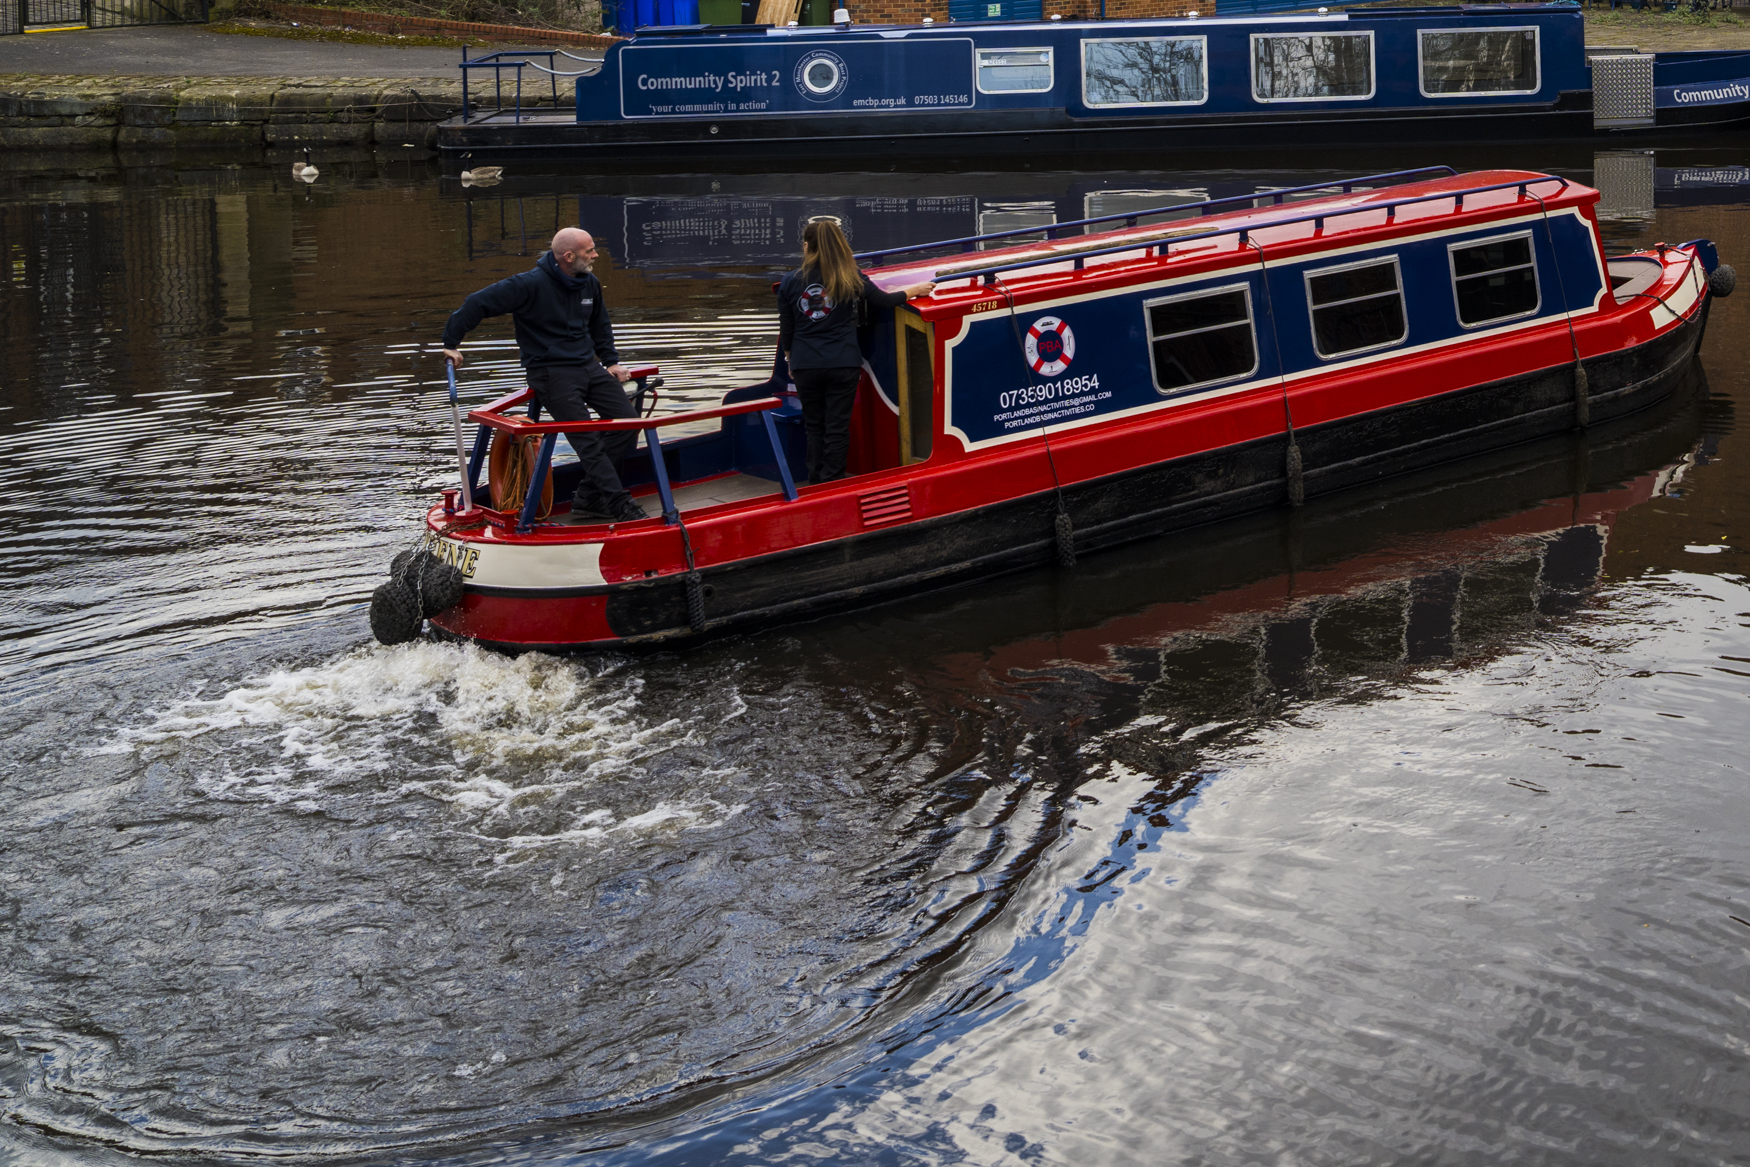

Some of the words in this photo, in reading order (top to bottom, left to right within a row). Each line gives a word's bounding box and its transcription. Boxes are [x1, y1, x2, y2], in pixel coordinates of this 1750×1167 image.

[811, 52, 840, 64] Community
[838, 62, 846, 75] Boat
[638, 72, 724, 92] Community
[727, 70, 768, 92] Spirit
[771, 70, 780, 86] 2
[853, 96, 907, 108] emcbp.org.uk
[914, 95, 938, 104] 07503
[940, 94, 969, 104] 145146
[1673, 83, 1749, 103] Community
[675, 101, 726, 114] community
[728, 100, 737, 110] in
[971, 300, 998, 313] 45718
[1038, 340, 1062, 354] PBA
[1000, 373, 1100, 408] 07359018954
